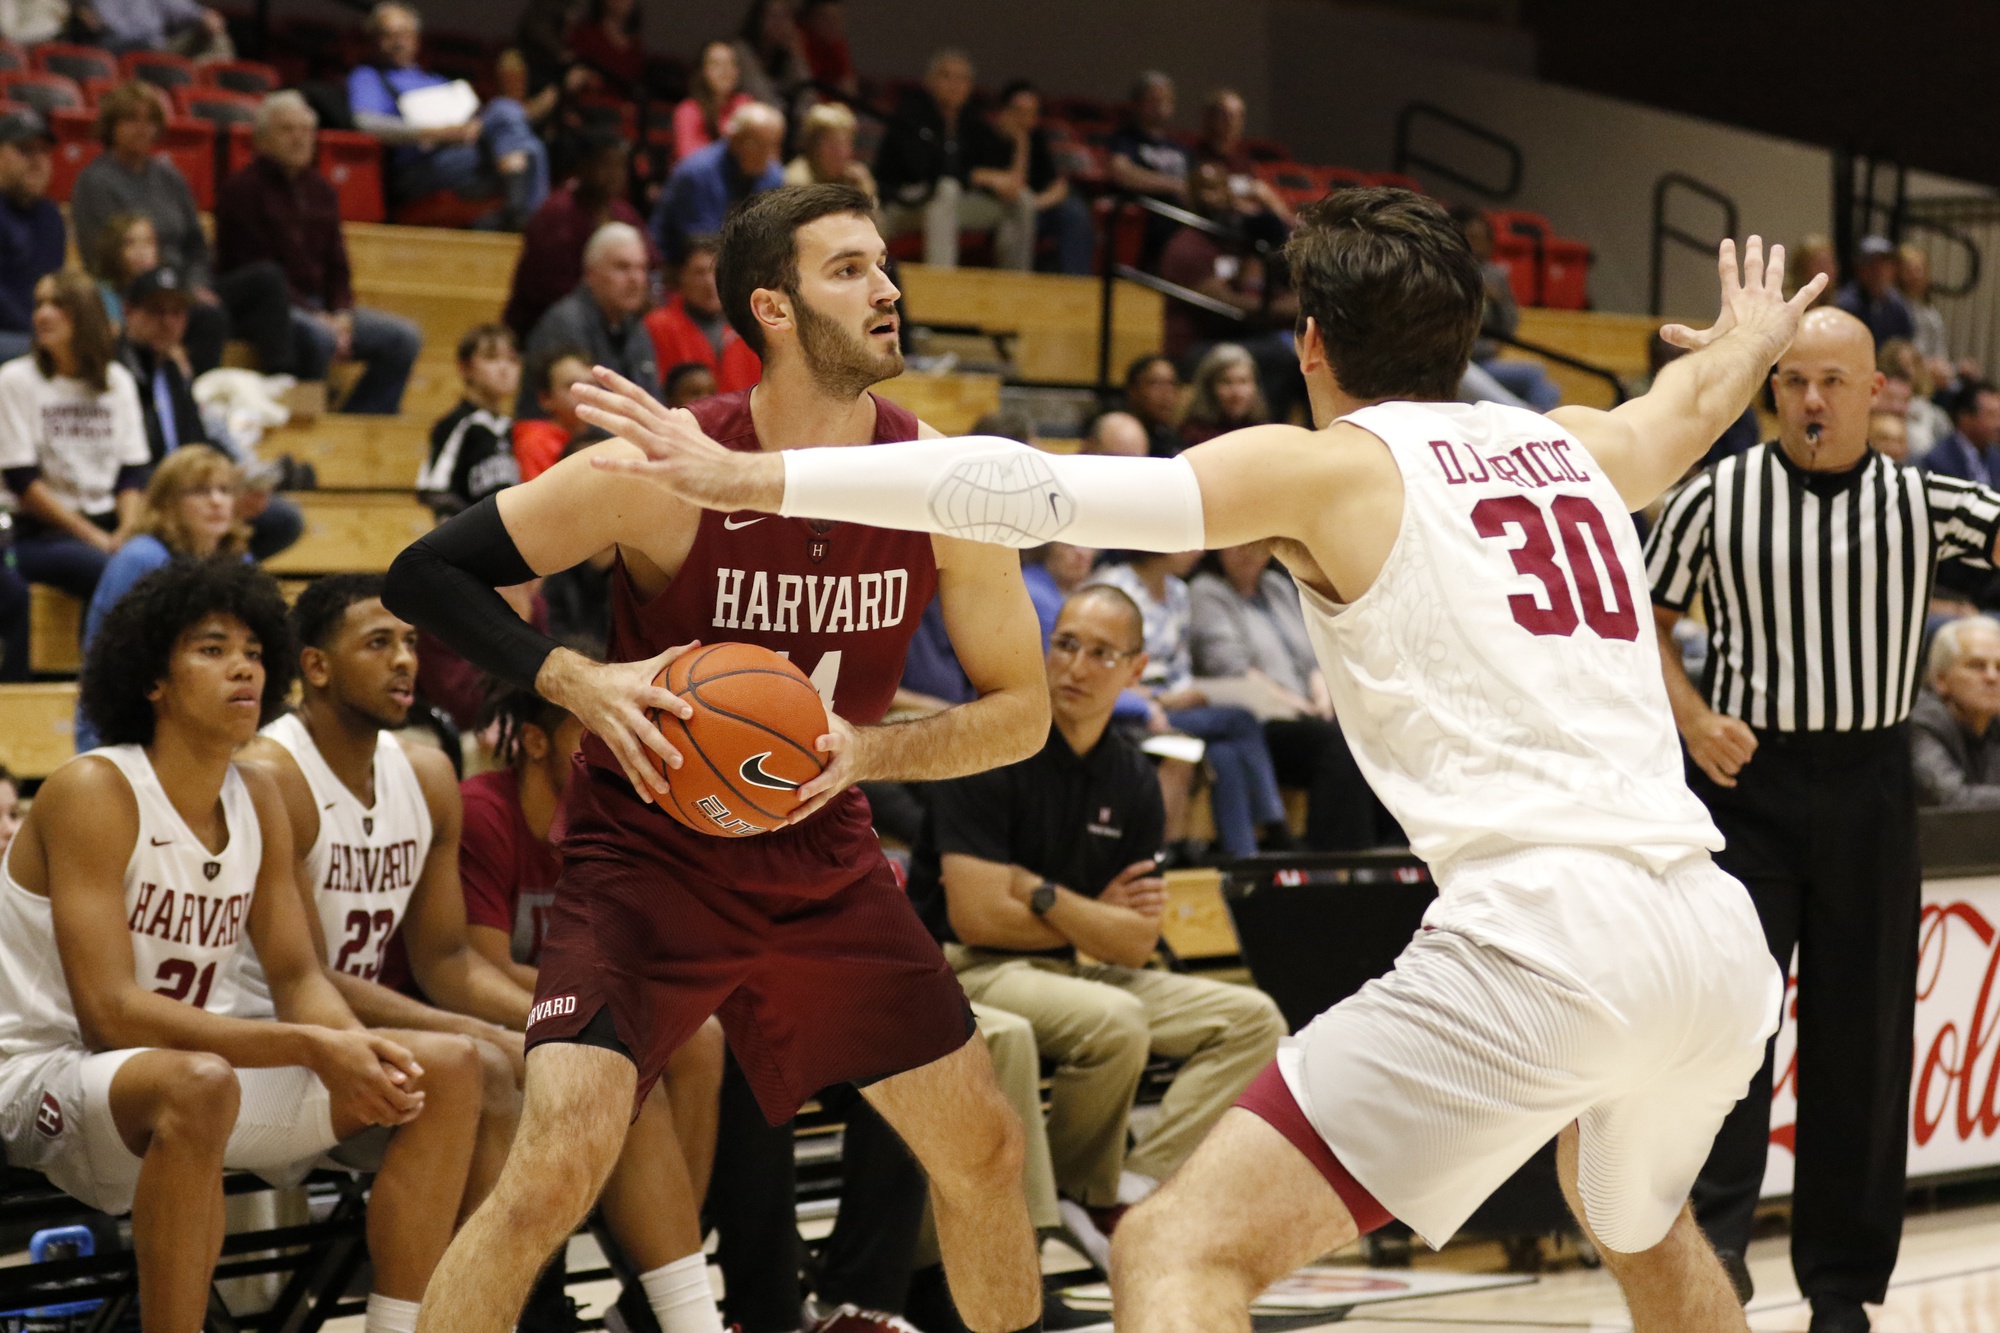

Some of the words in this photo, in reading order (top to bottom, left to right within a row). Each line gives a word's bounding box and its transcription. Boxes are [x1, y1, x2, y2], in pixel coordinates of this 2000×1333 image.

[813, 544, 823, 557] H
[1470, 494, 1640, 642] 30
[712, 568, 908, 633] HARVARD
[334, 909, 394, 982] 23
[153, 958, 217, 1009] 21
[526, 995, 576, 1031] RVARD
[39, 1102, 59, 1131] H
